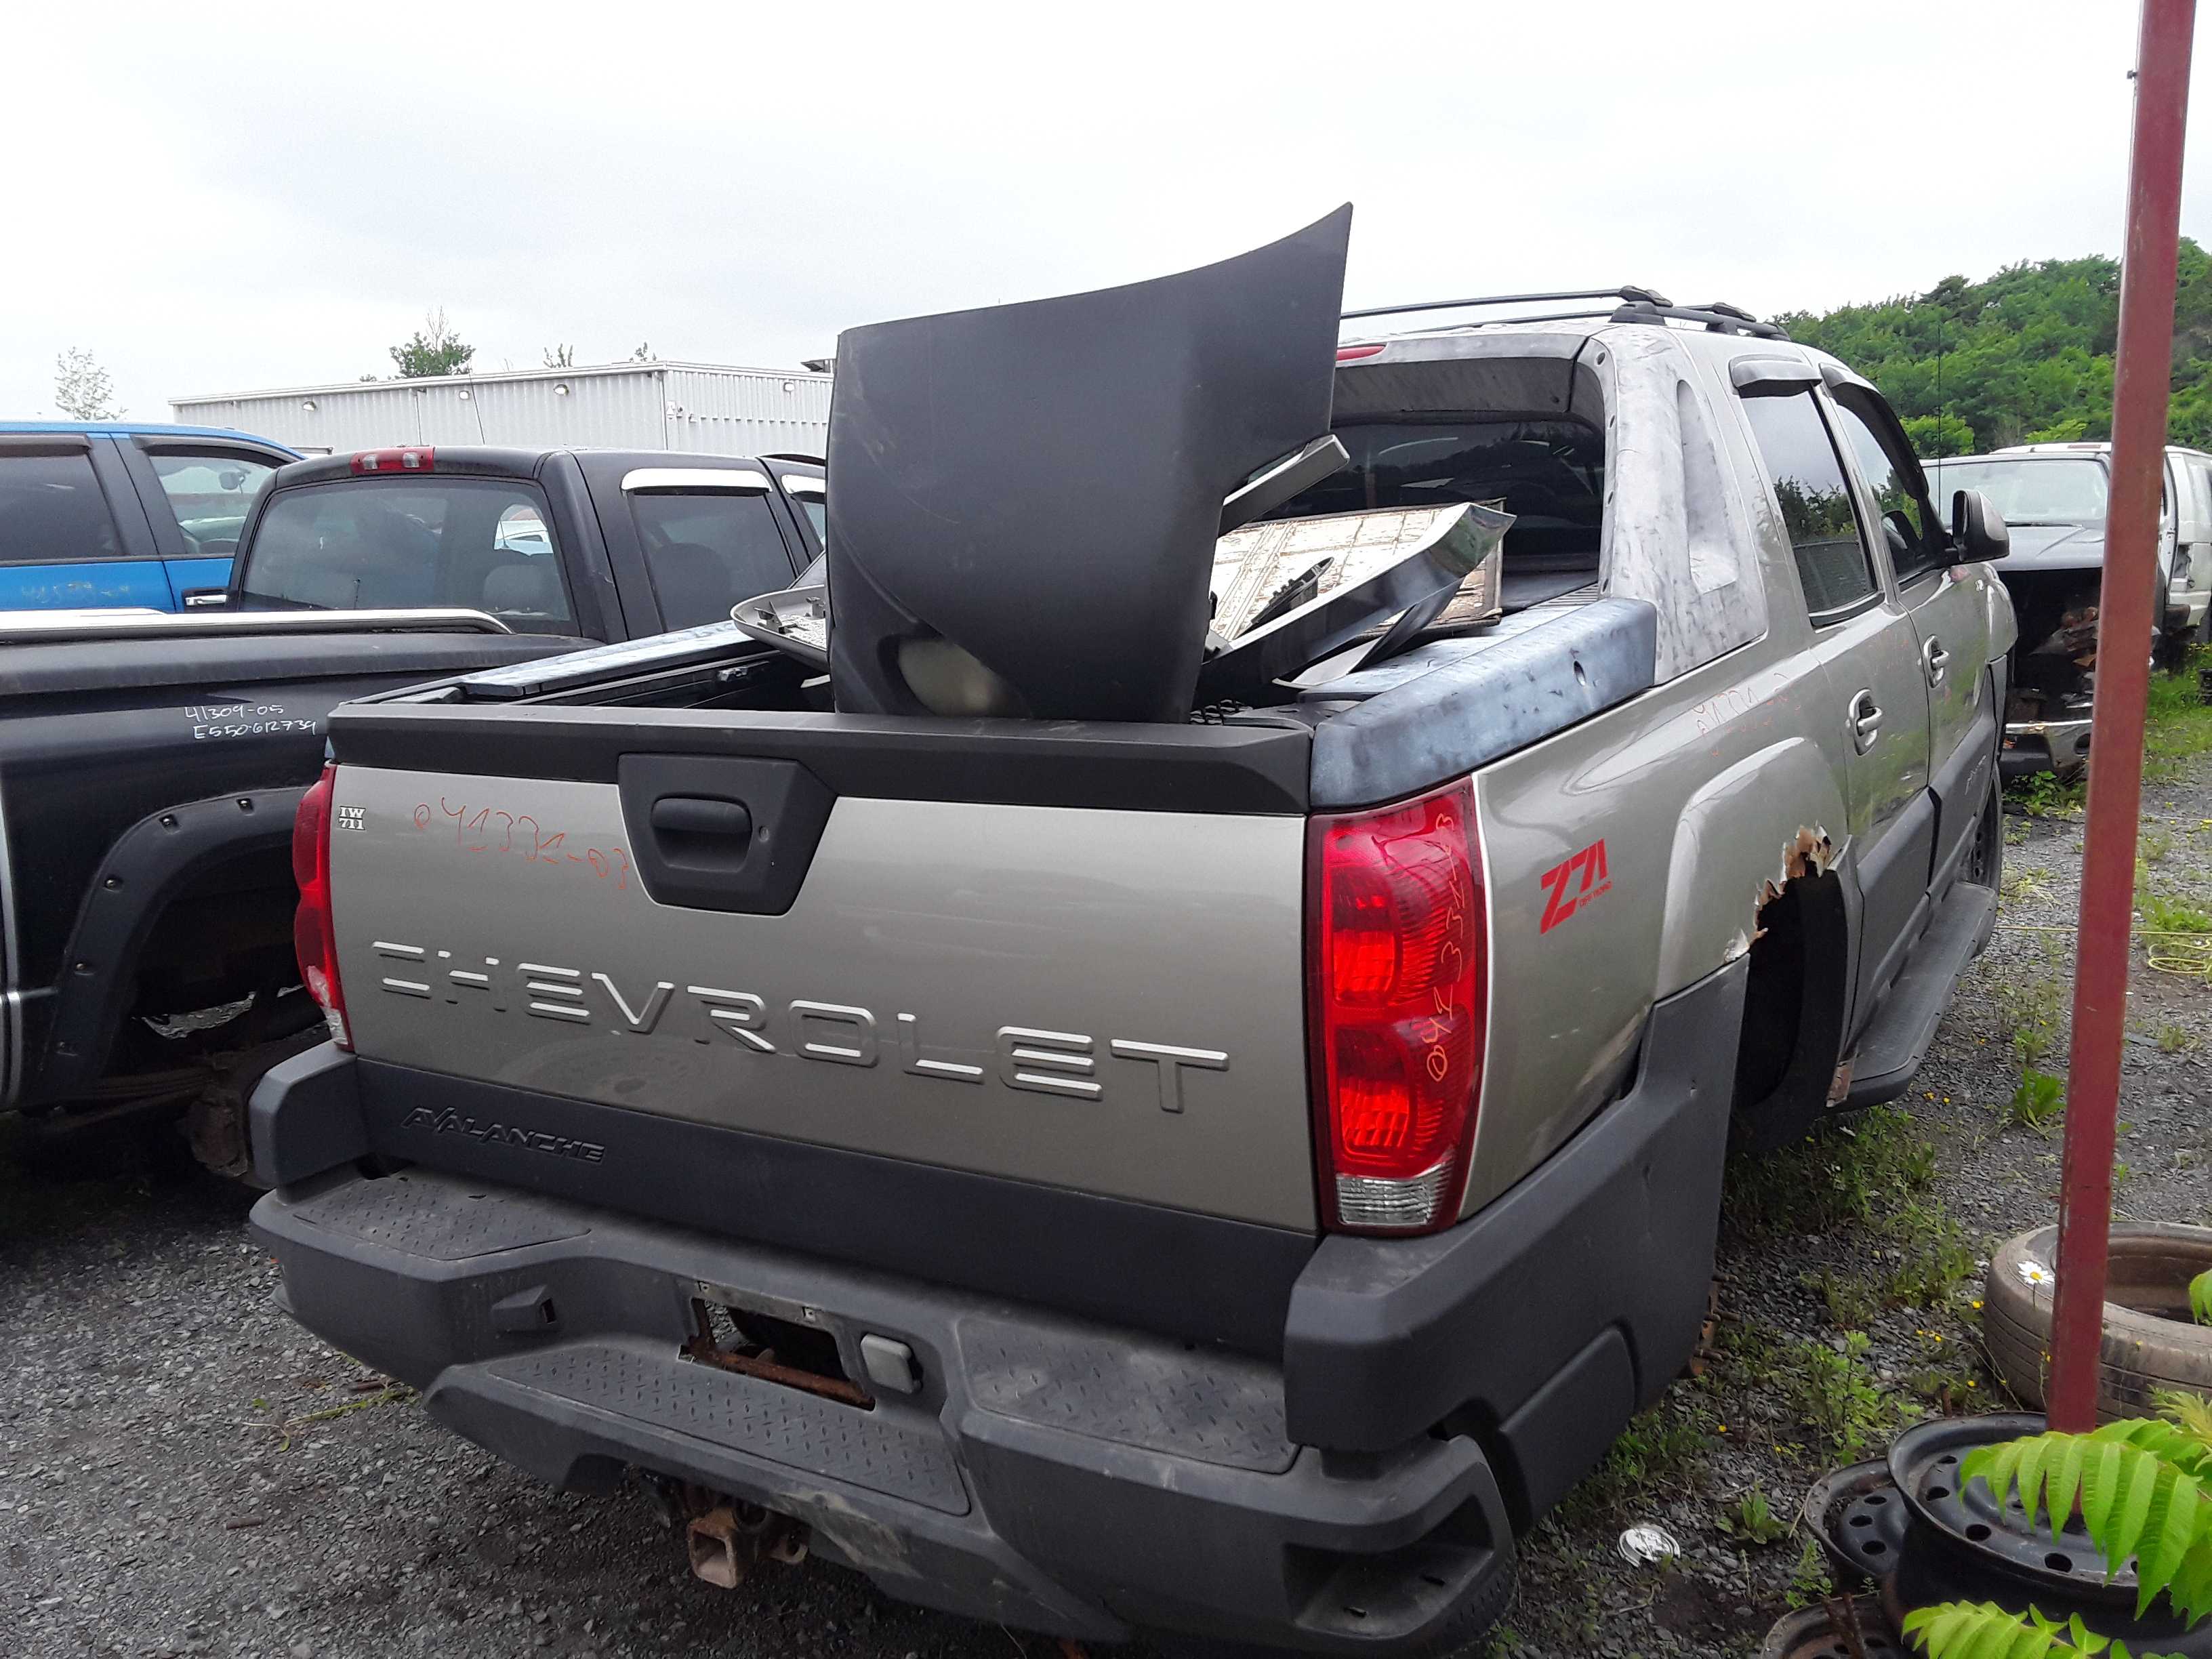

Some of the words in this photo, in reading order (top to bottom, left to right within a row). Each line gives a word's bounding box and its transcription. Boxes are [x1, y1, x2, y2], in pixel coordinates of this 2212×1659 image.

[185, 704, 284, 722] 41309-05
[340, 806, 365, 818] IW
[1540, 838, 1610, 936] Z71
[373, 941, 1229, 1114] CHEVROLET
[401, 1106, 606, 1164] AVALANCHE
